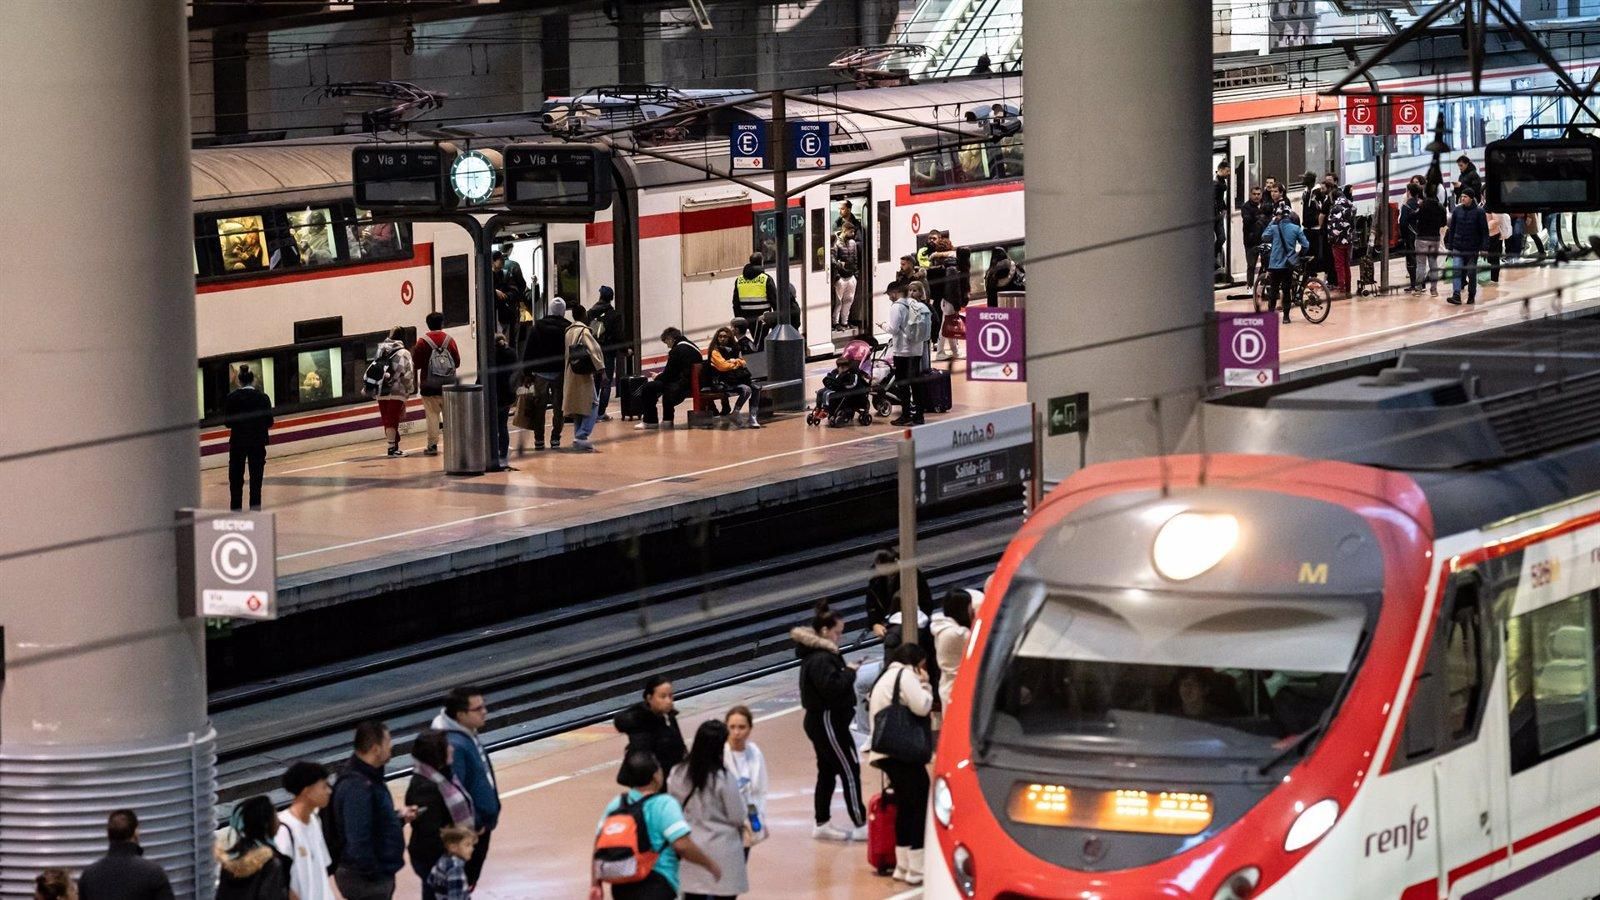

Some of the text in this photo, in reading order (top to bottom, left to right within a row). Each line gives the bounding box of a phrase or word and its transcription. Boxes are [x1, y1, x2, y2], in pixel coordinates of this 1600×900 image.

[1357, 107, 1366, 120] F
[1404, 107, 1413, 120] F
[743, 136, 752, 151] E
[806, 137, 815, 152] E
[401, 154, 407, 164] 3
[551, 155, 558, 164] 4
[979, 312, 1009, 320] SECTOR
[1233, 318, 1264, 326] SECTOR
[987, 328, 1005, 351] D
[1241, 334, 1260, 357] D
[952, 425, 985, 447] Atocha
[213, 520, 254, 531] SECTOR
[221, 541, 248, 576] C
[1299, 563, 1328, 584] M
[1365, 804, 1429, 861] renfe
